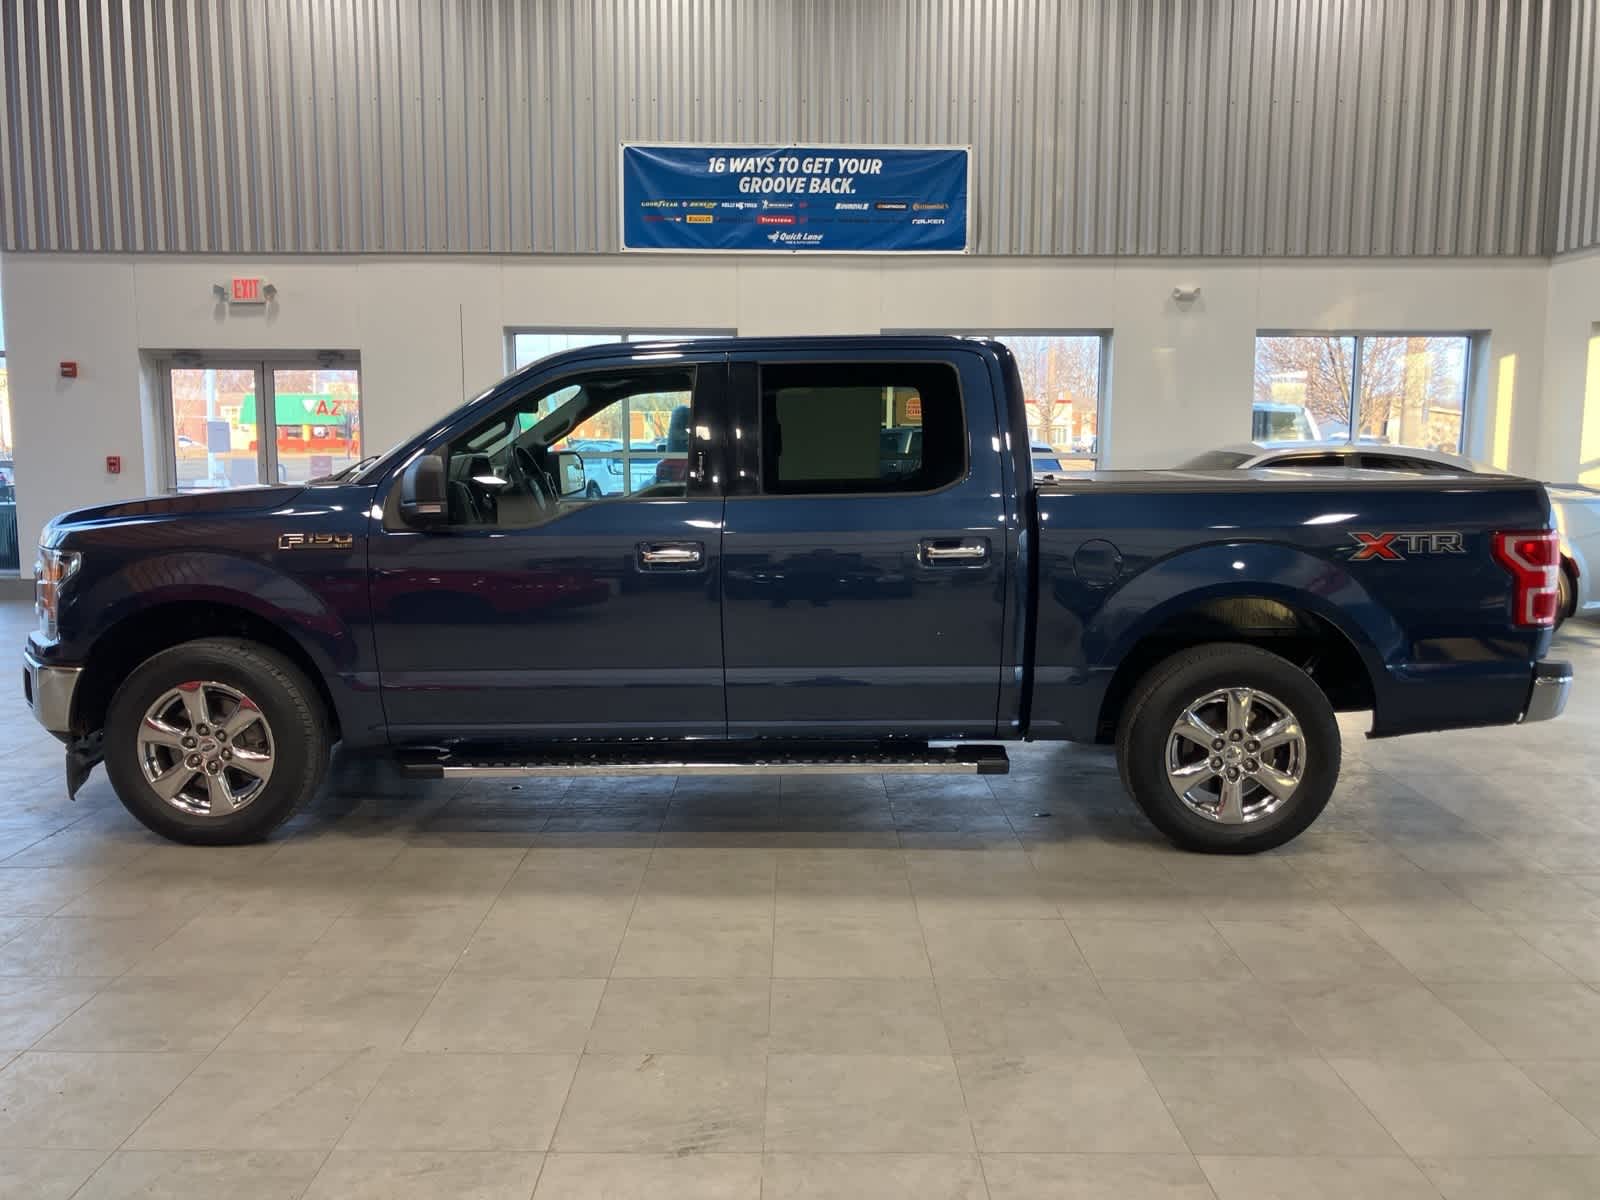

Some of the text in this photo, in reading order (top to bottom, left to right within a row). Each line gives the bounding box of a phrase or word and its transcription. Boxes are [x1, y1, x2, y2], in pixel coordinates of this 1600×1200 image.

[707, 156, 883, 175] 16 WAYS TO GET YOUR
[738, 176, 857, 195] GROOVE BACK.
[779, 232, 824, 241] Quick Lane
[233, 279, 259, 299] EXIT
[1348, 531, 1466, 561] XTR
